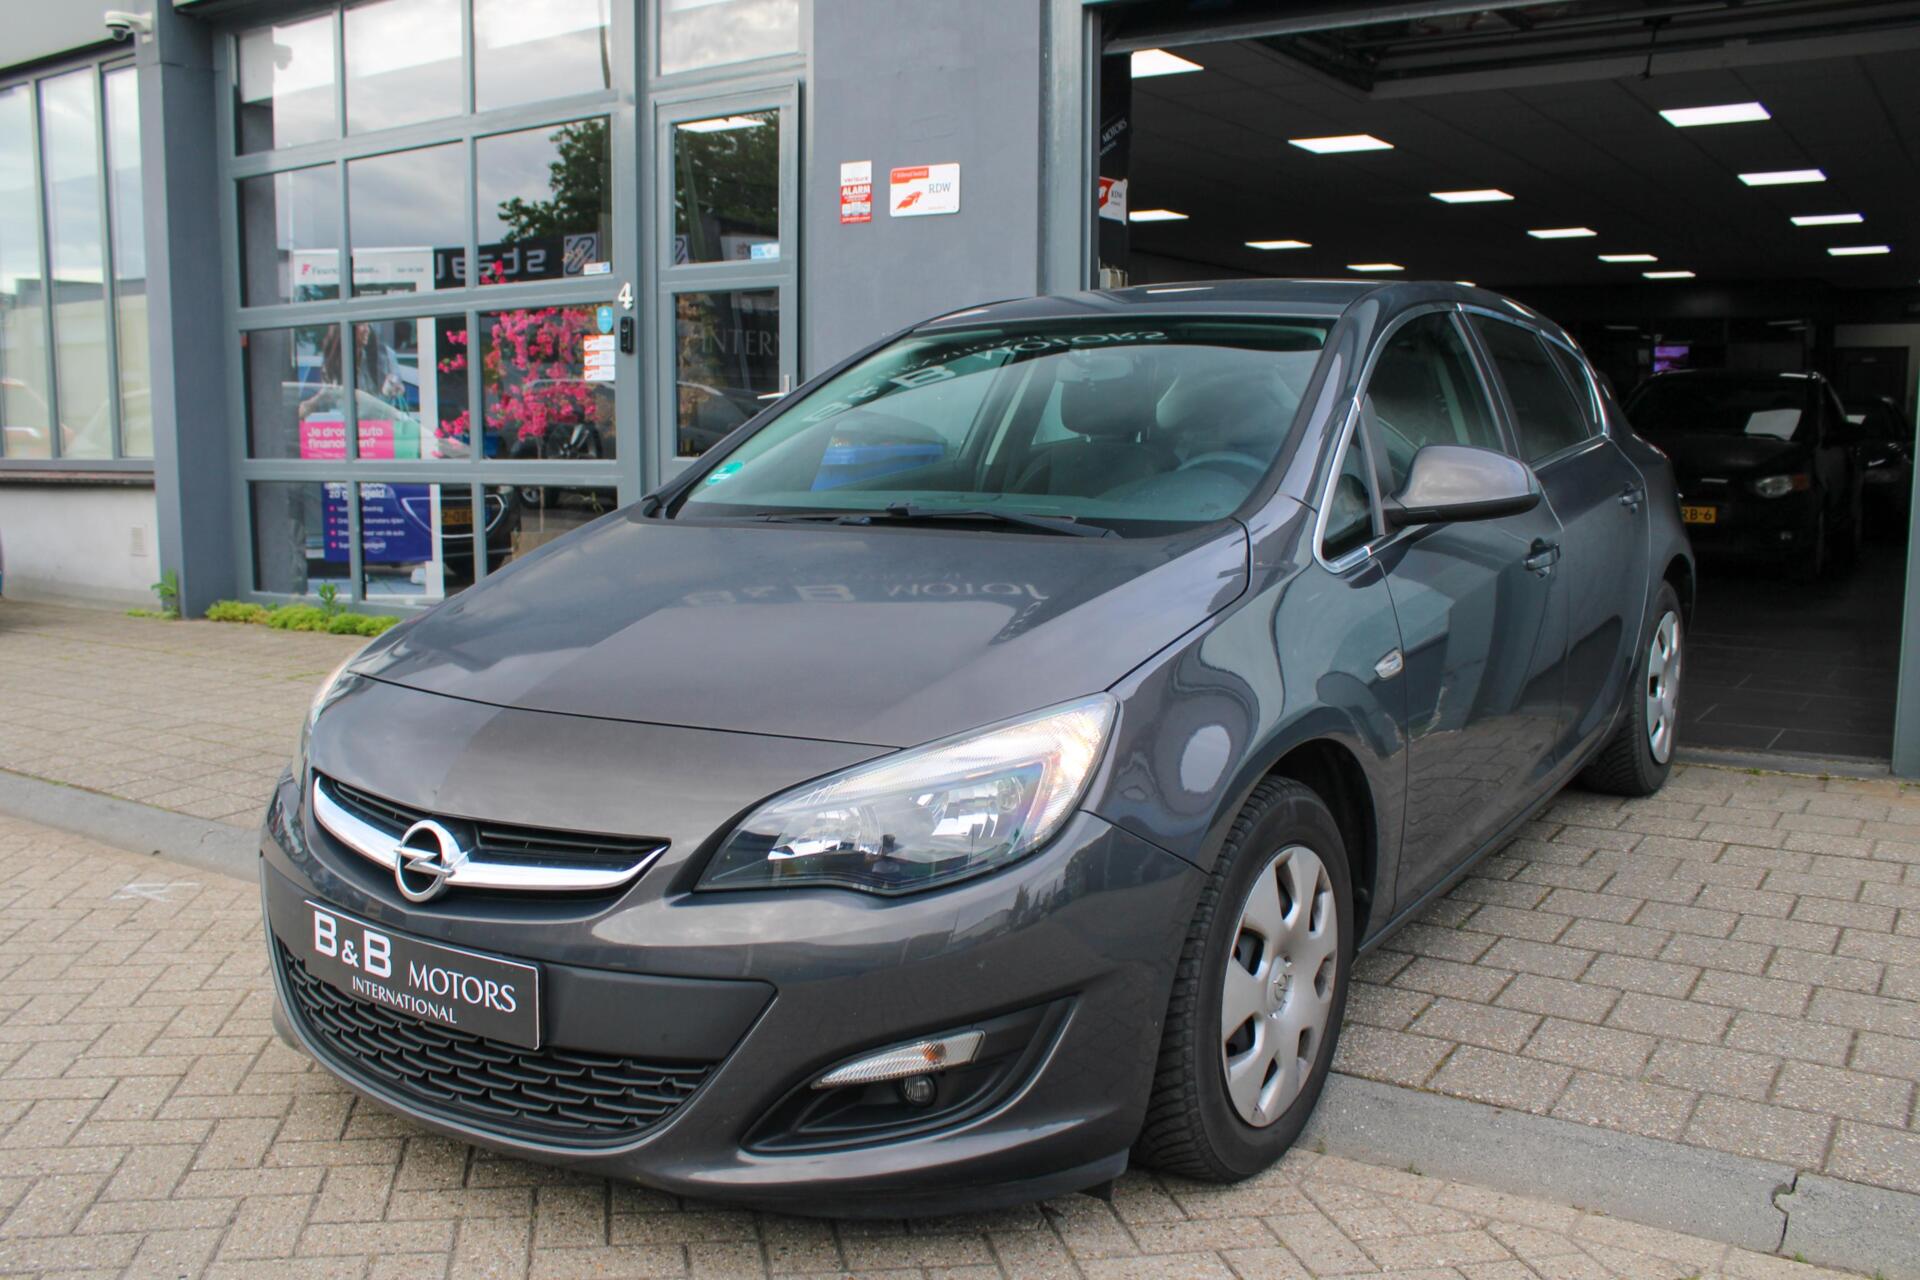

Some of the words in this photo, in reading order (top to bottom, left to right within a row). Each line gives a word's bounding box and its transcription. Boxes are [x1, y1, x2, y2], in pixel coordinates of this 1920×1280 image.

[842, 184, 871, 197] ALARM
[928, 182, 951, 194] RDW
[618, 282, 633, 310] 4
[351, 976, 458, 1024] INTERNATIONAL
[408, 960, 517, 1014] MOTORS
